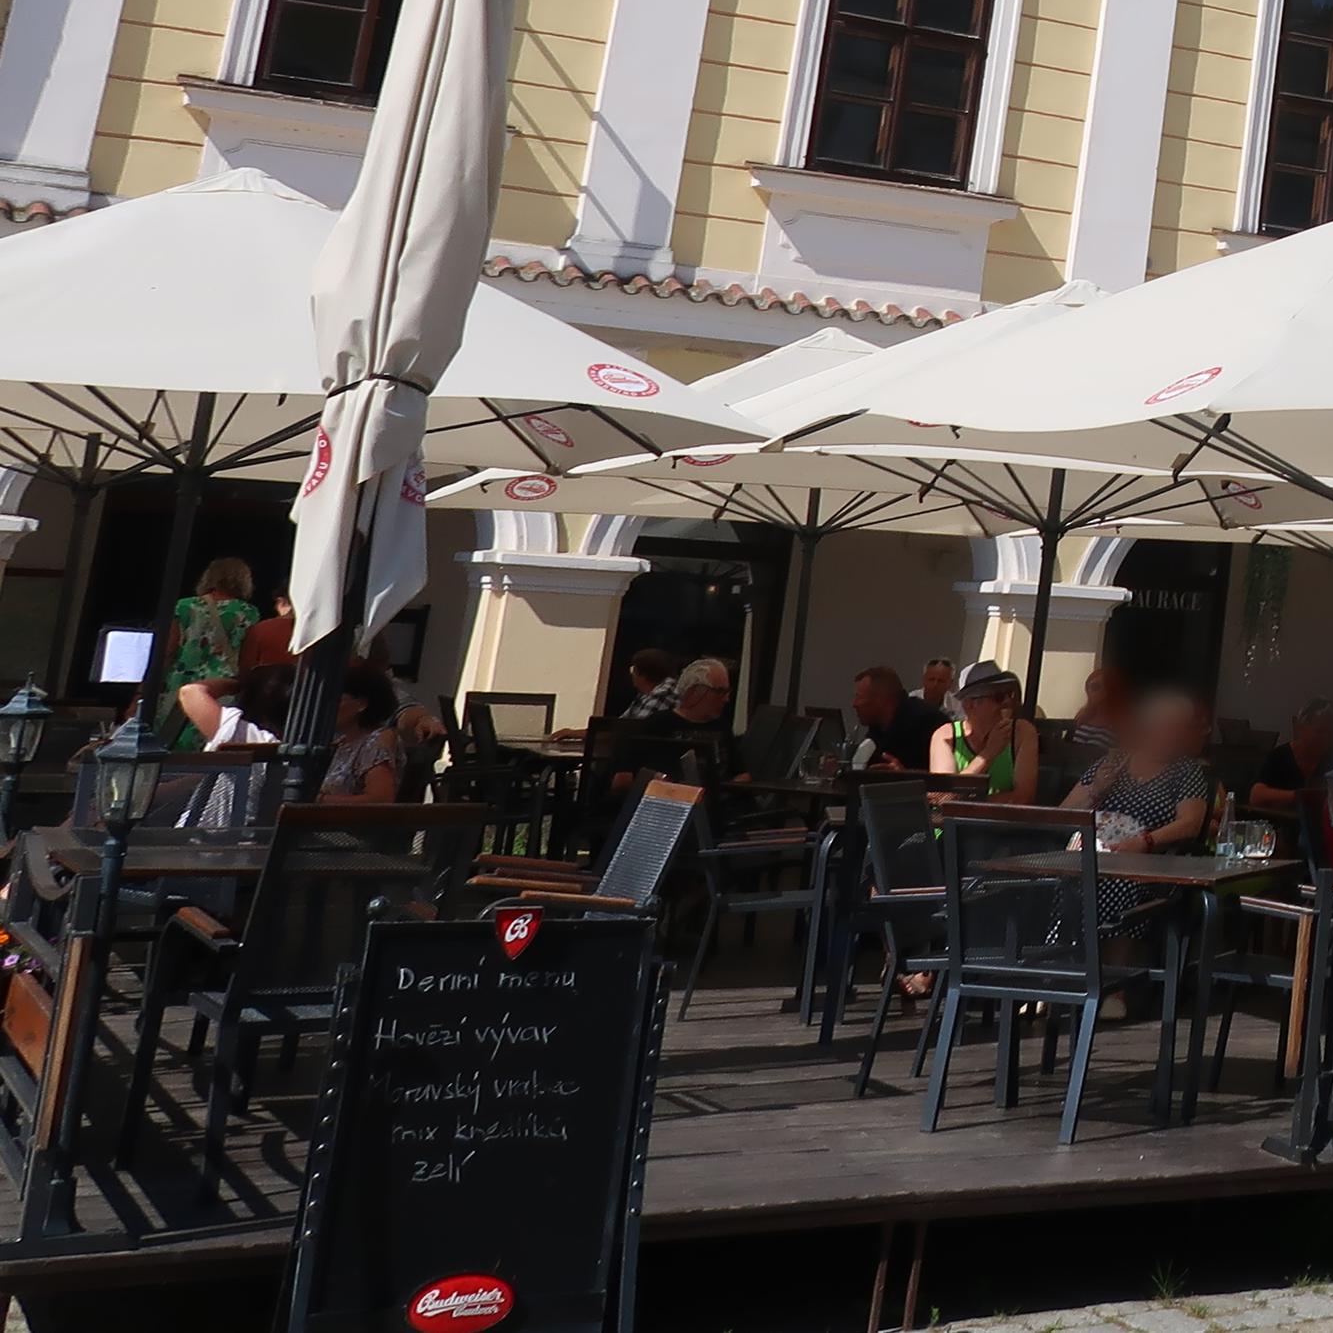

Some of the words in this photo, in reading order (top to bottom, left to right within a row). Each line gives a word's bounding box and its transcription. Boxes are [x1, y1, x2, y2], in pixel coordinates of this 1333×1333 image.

[474, 1011, 558, 1062] vývar
[411, 1149, 477, 1184] zelí
[416, 1288, 505, 1317] Budweiser
